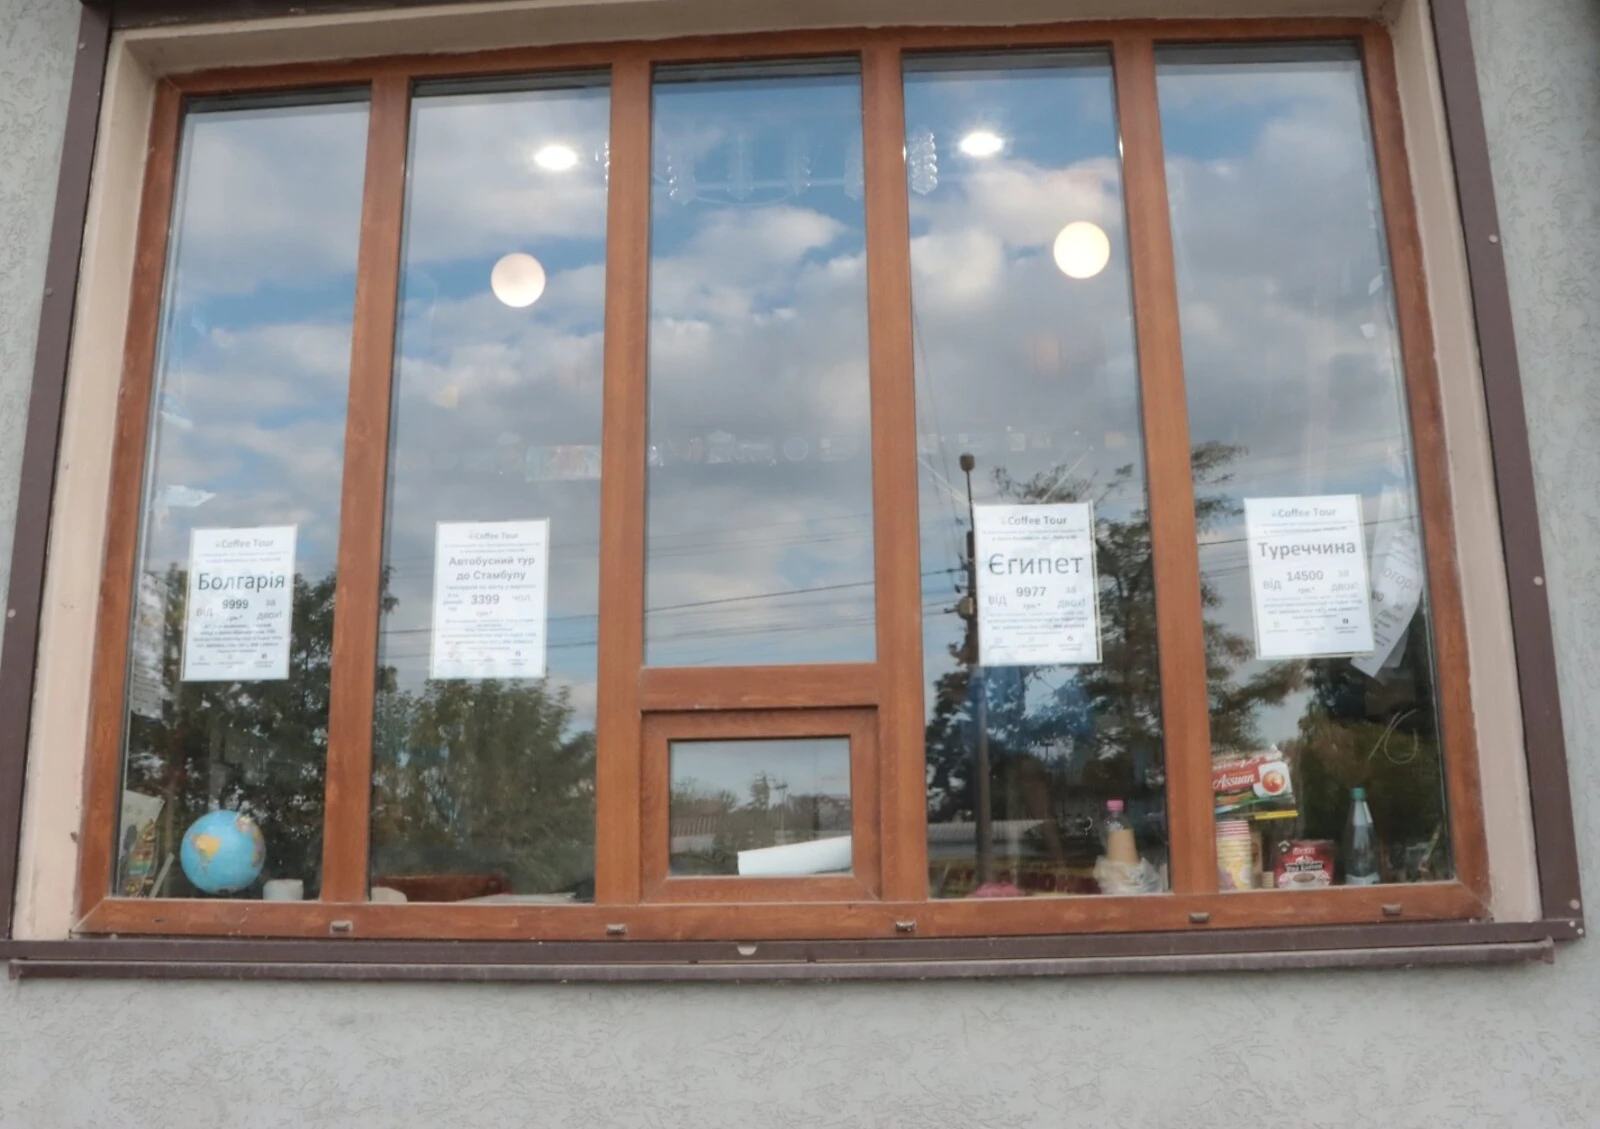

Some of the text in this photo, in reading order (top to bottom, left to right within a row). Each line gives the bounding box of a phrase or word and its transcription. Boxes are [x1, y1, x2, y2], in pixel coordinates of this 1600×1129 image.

[1277, 507, 1337, 518] Coffee Tour
[1007, 515, 1068, 526] Coffee Tour
[475, 531, 519, 541] Coffee Tour
[221, 538, 275, 549] Coffee Tour
[1257, 541, 1357, 560] Туреччина
[448, 554, 536, 568] Автобусний тур
[988, 553, 1084, 576] Єгипет
[198, 570, 286, 594] Болгарія
[455, 569, 527, 582] до Стамбулу
[1286, 569, 1324, 582] 14500
[1015, 586, 1047, 598] 9977
[222, 599, 250, 611] 9999
[470, 593, 501, 606] 3399
